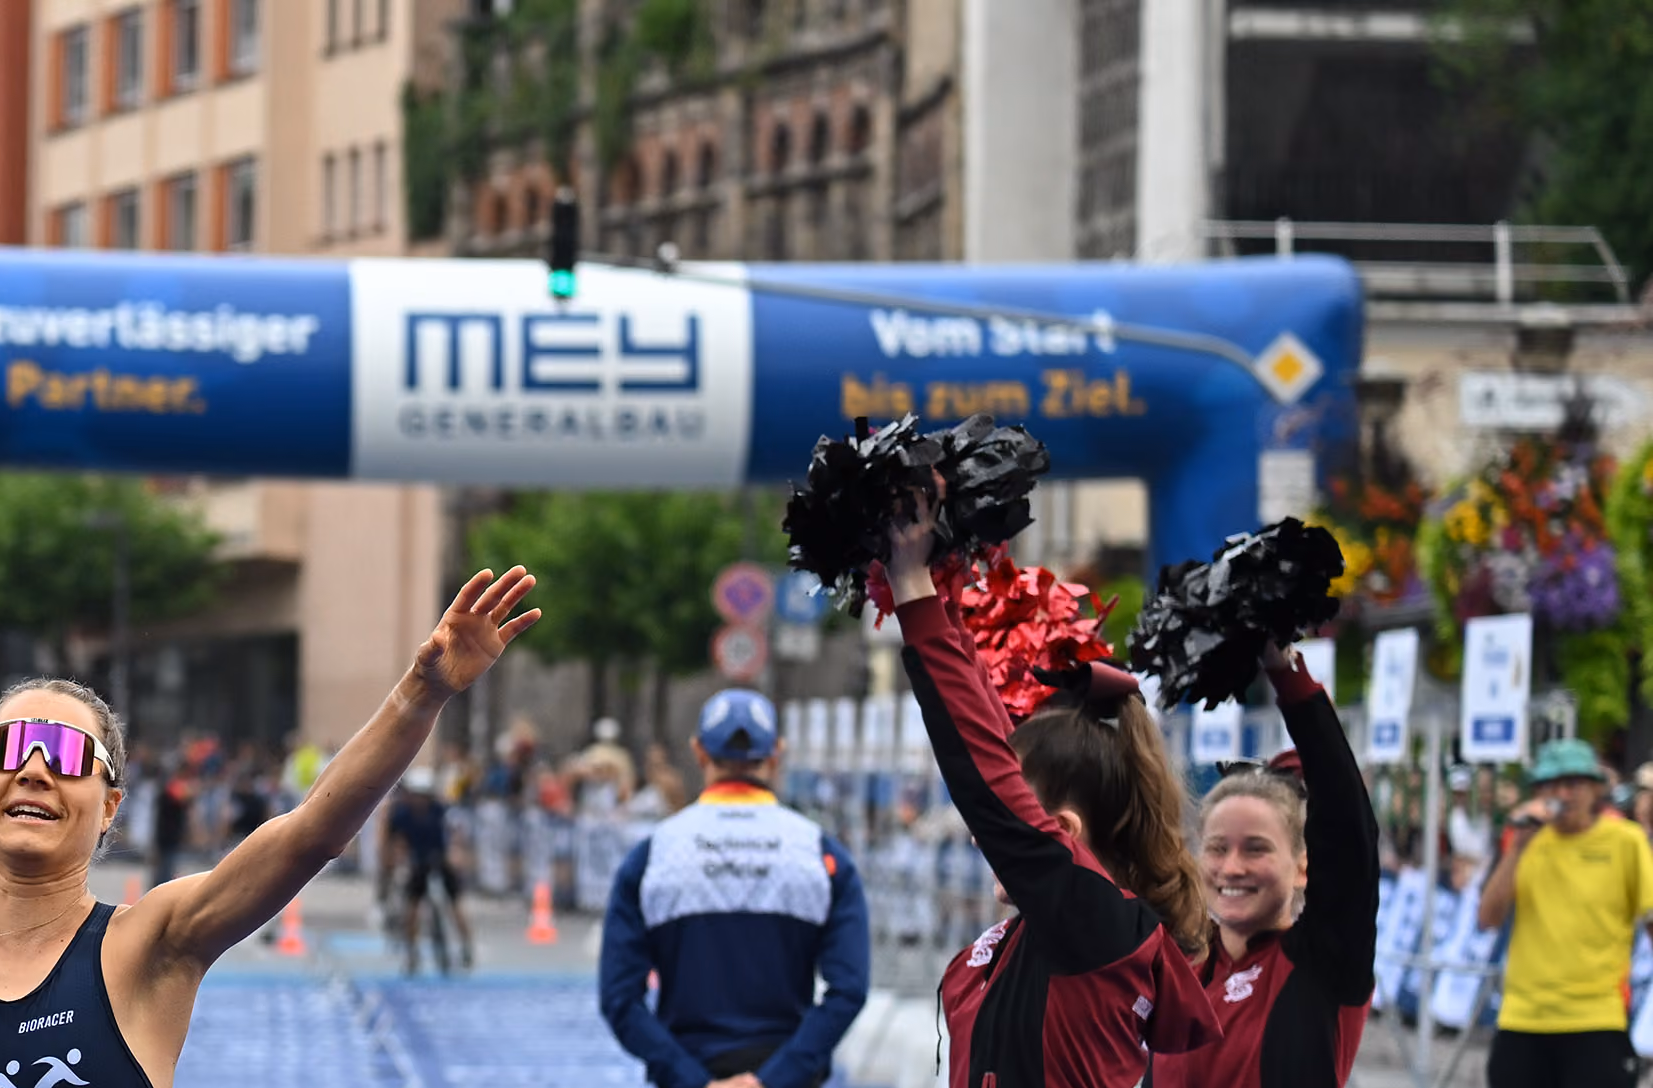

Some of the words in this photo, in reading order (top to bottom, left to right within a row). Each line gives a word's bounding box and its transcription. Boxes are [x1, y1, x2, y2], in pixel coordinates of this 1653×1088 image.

[405, 312, 700, 392] MEY
[869, 308, 983, 358] Vom
[840, 370, 915, 419] bis
[923, 378, 1030, 418] zum
[399, 406, 705, 442] GENERALBAU
[18, 1010, 74, 1034] BIORACER
